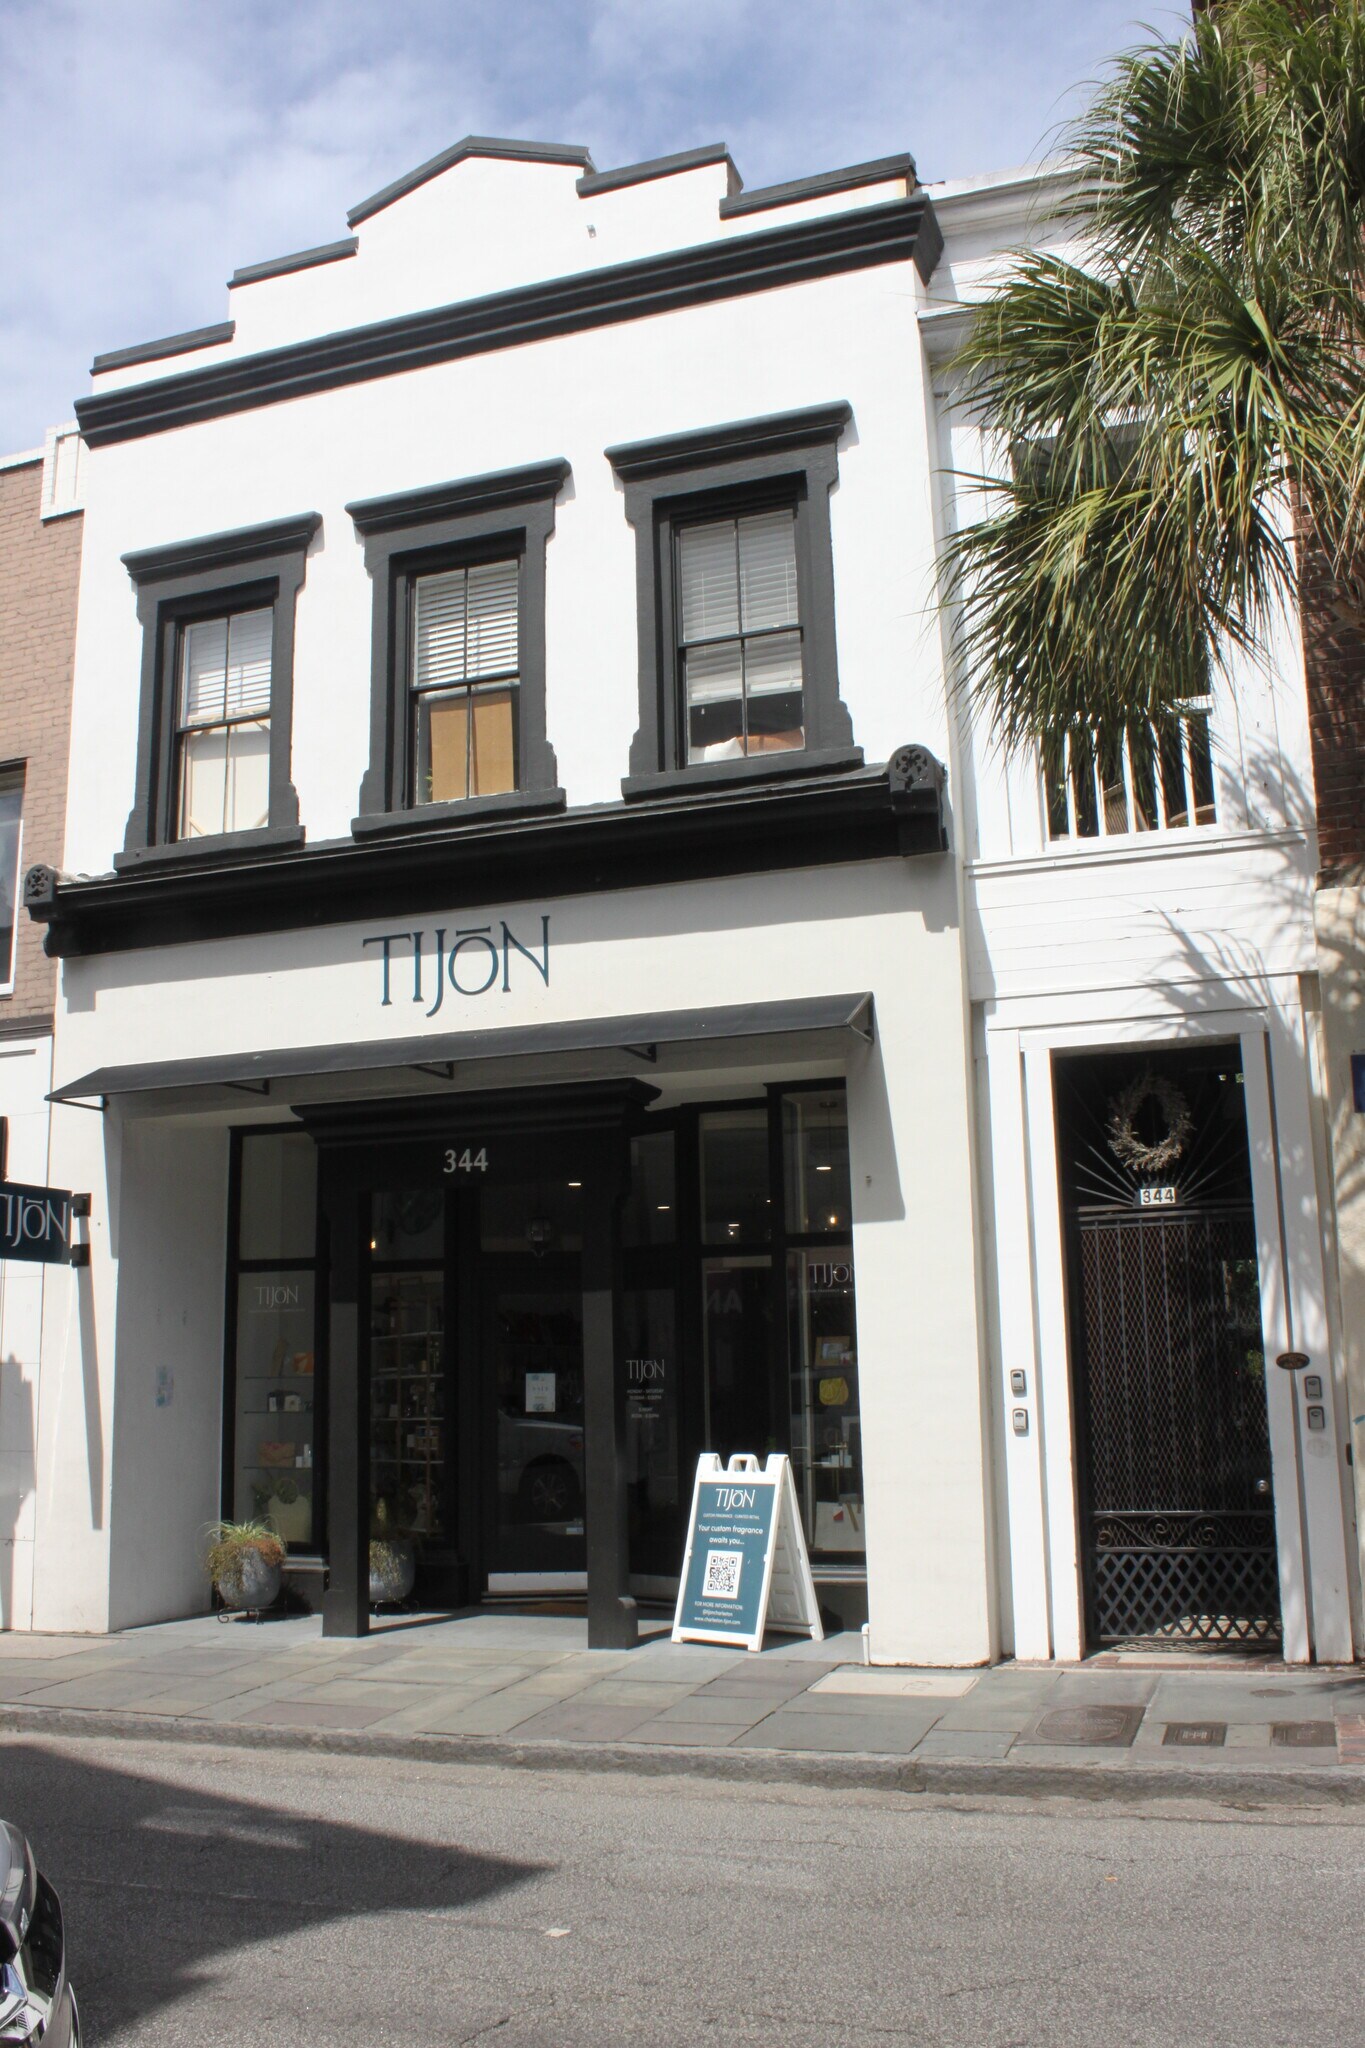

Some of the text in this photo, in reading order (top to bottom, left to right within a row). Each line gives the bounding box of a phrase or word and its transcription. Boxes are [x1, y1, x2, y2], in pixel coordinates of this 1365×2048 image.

[443, 1148, 489, 1173] 344
[1142, 1188, 1174, 1203] 344
[698, 1524, 763, 1535] Your custom fragrance
